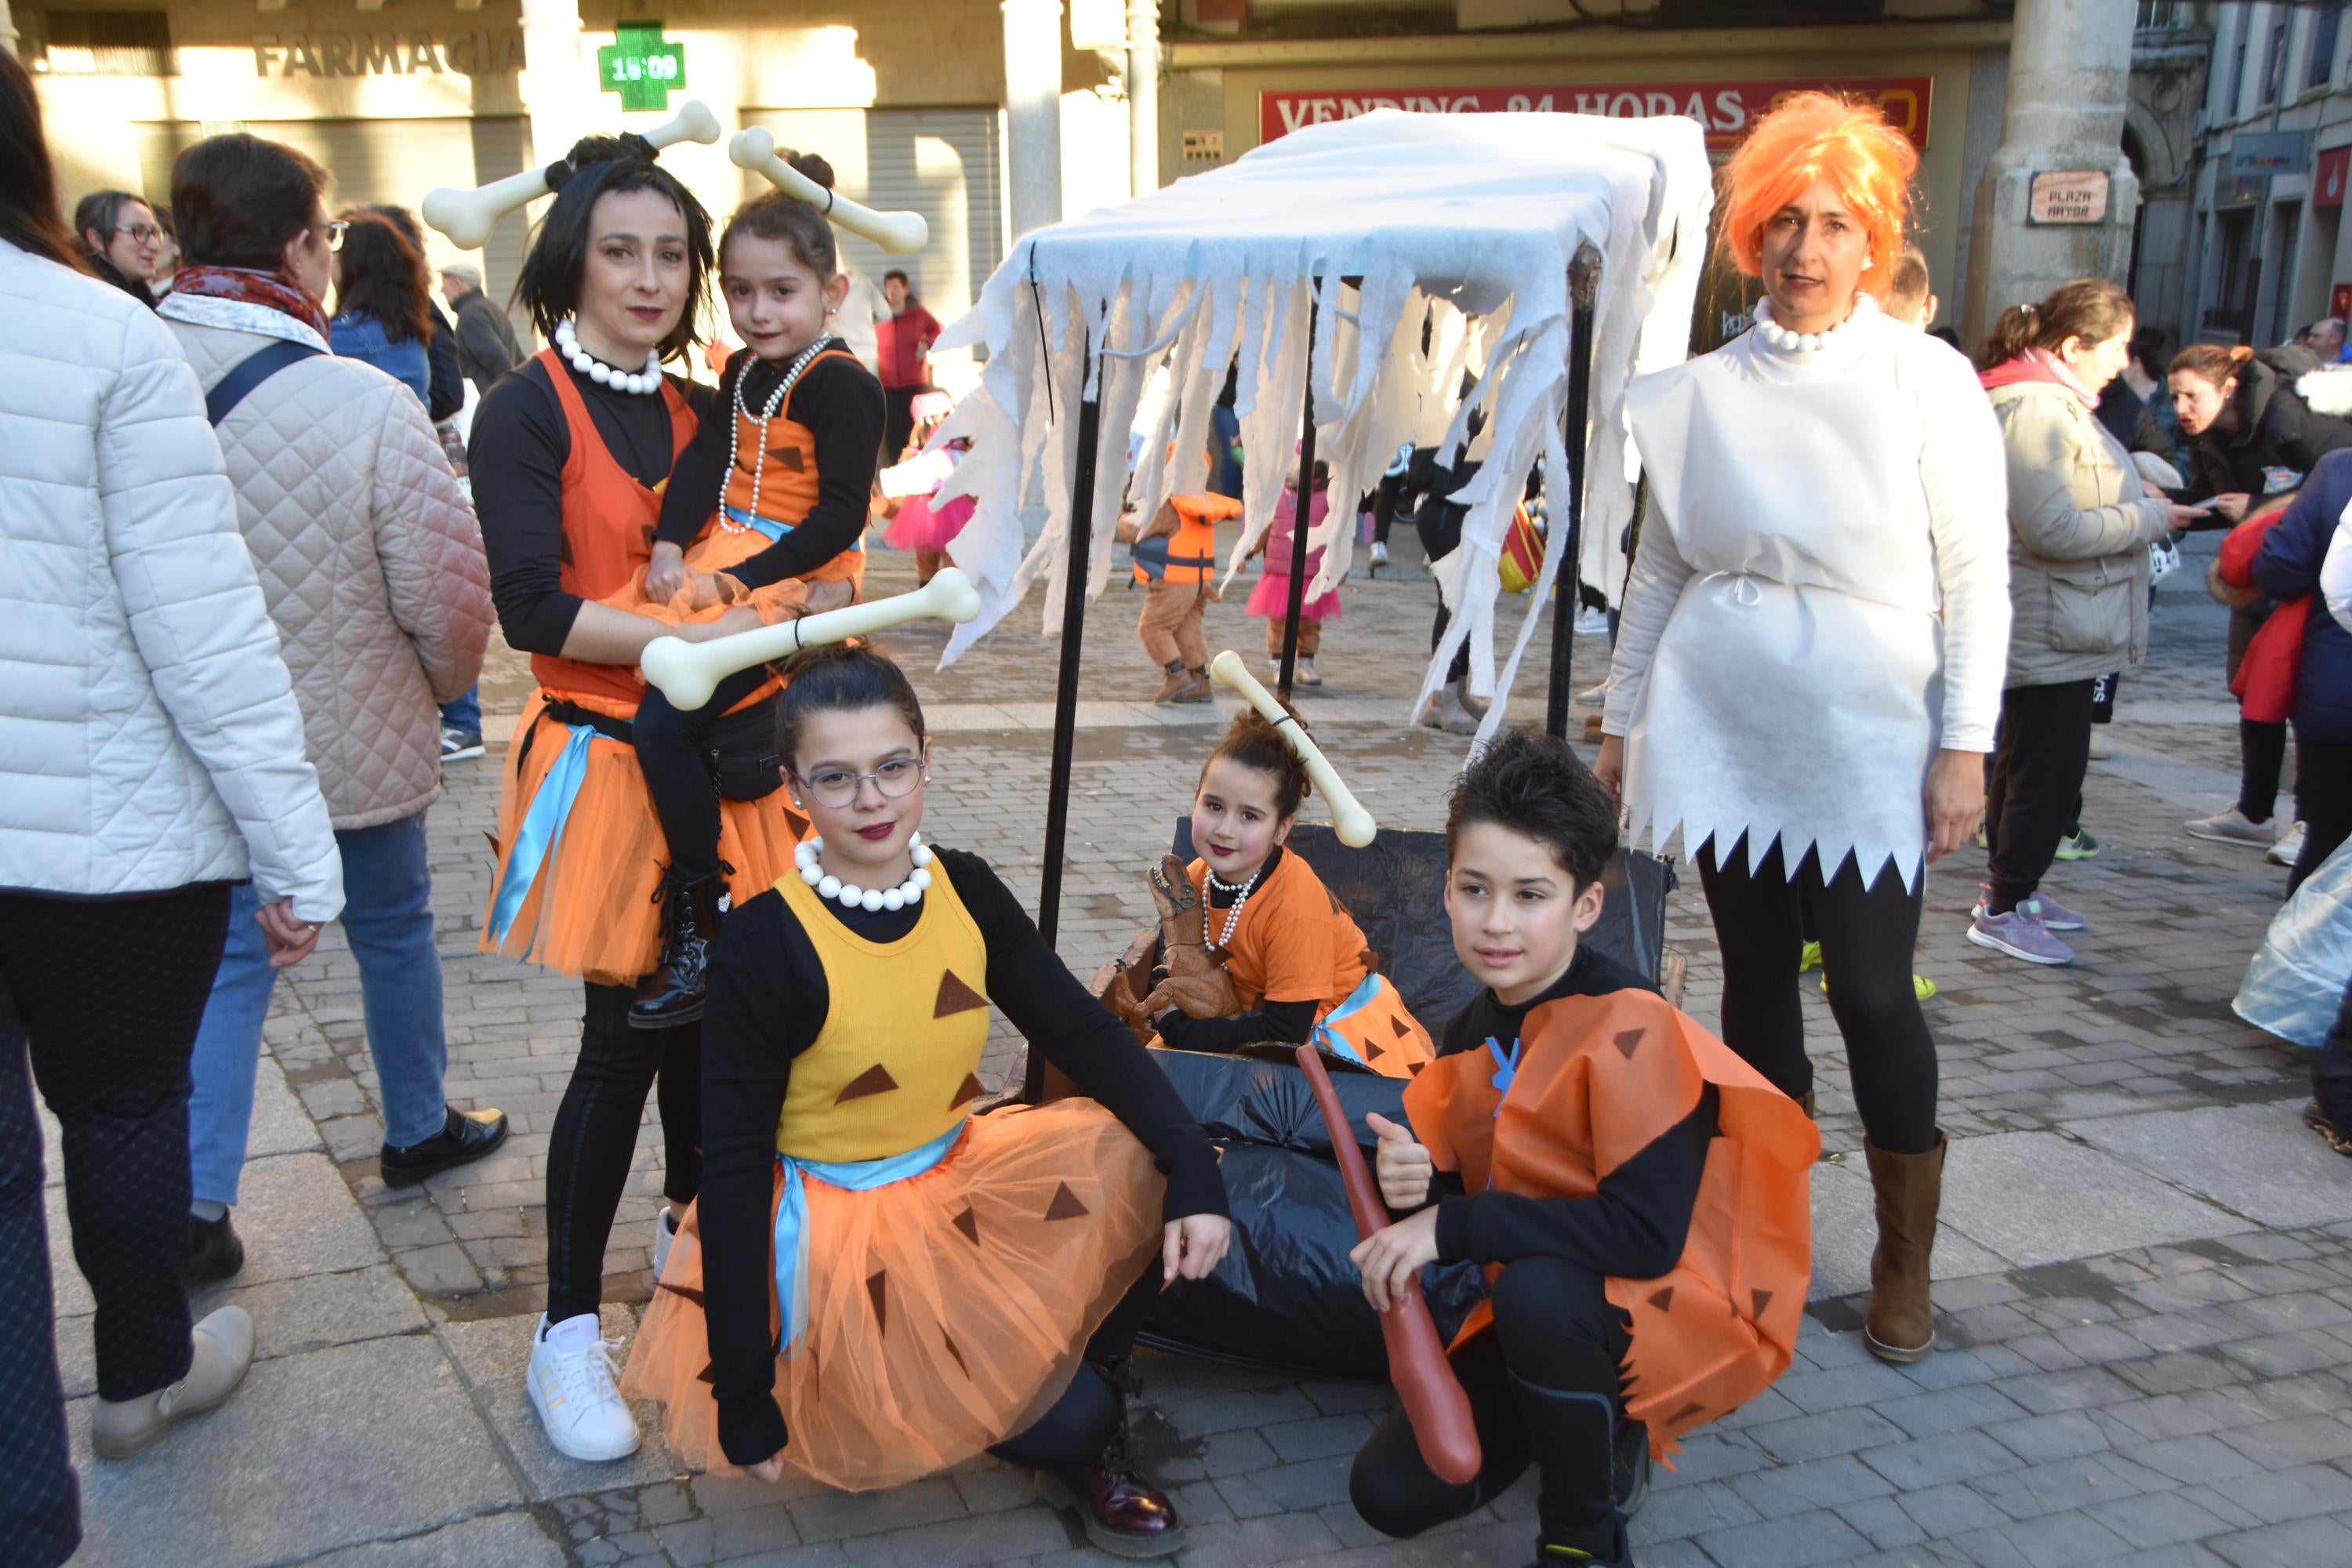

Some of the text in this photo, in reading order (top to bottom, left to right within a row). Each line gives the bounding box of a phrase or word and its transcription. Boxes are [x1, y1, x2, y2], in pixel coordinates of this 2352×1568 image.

[252, 30, 526, 77] FARMACIA
[2049, 191, 2091, 201] PLAZA
[2048, 205, 2089, 216] MAYOR
